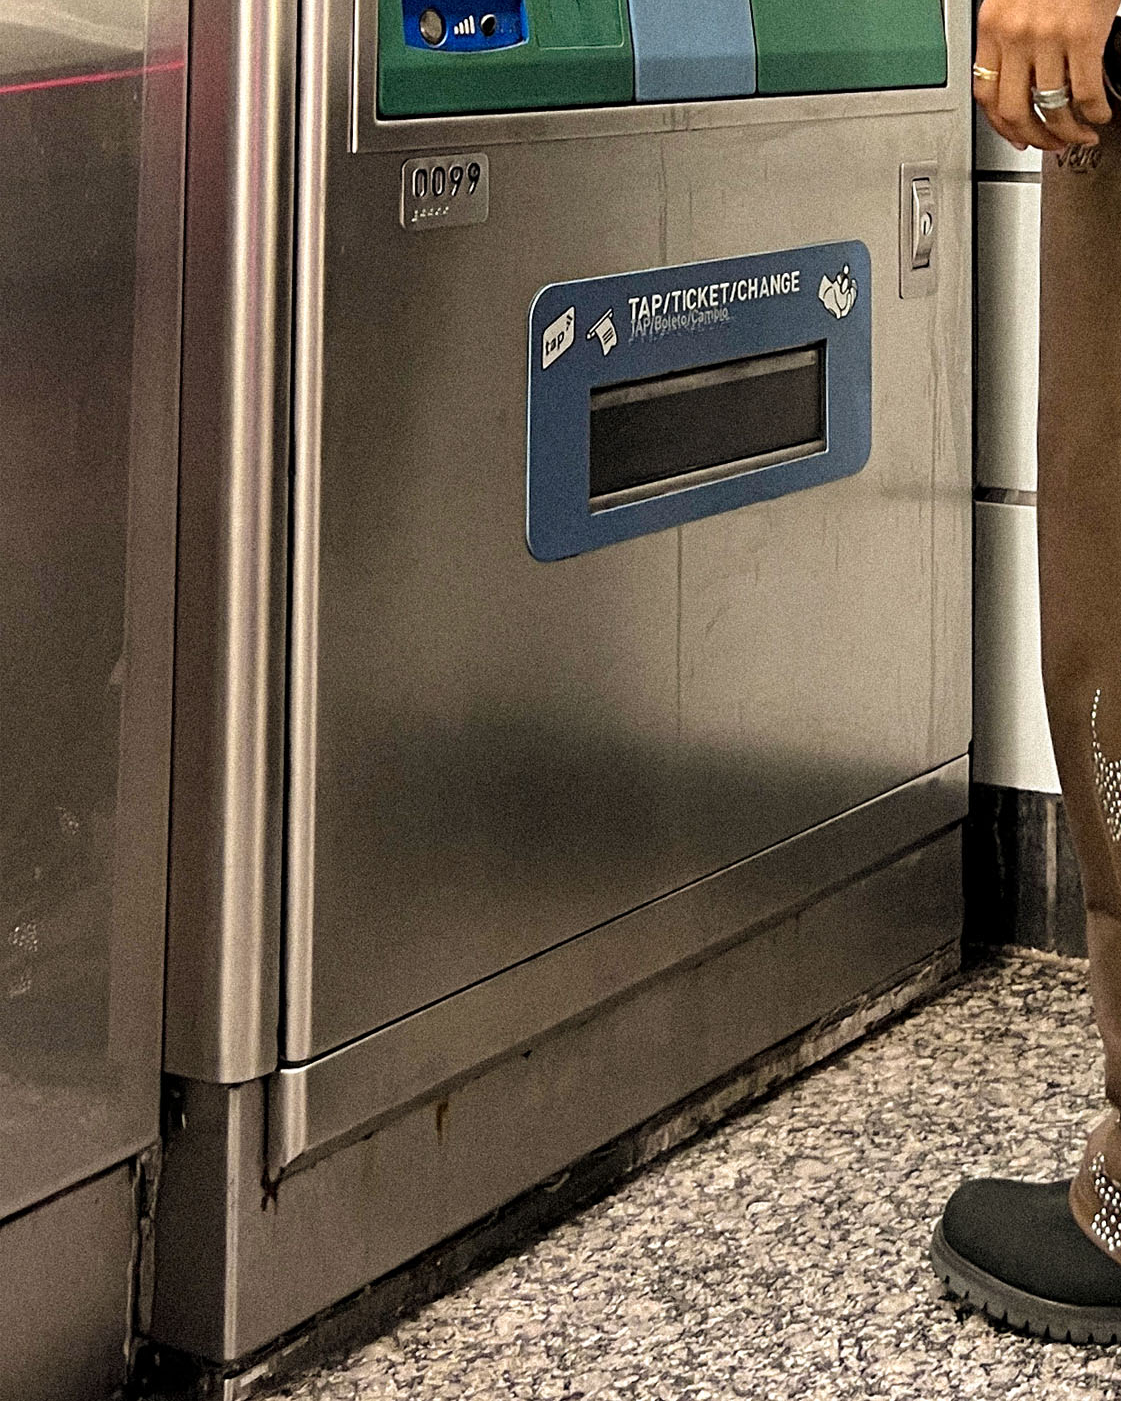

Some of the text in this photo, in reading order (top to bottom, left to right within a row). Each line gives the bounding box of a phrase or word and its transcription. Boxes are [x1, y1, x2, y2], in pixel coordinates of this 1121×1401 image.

[412, 162, 481, 197] 0099
[628, 270, 801, 320] TAP/TICKET/CHANGE
[545, 331, 565, 356] tap
